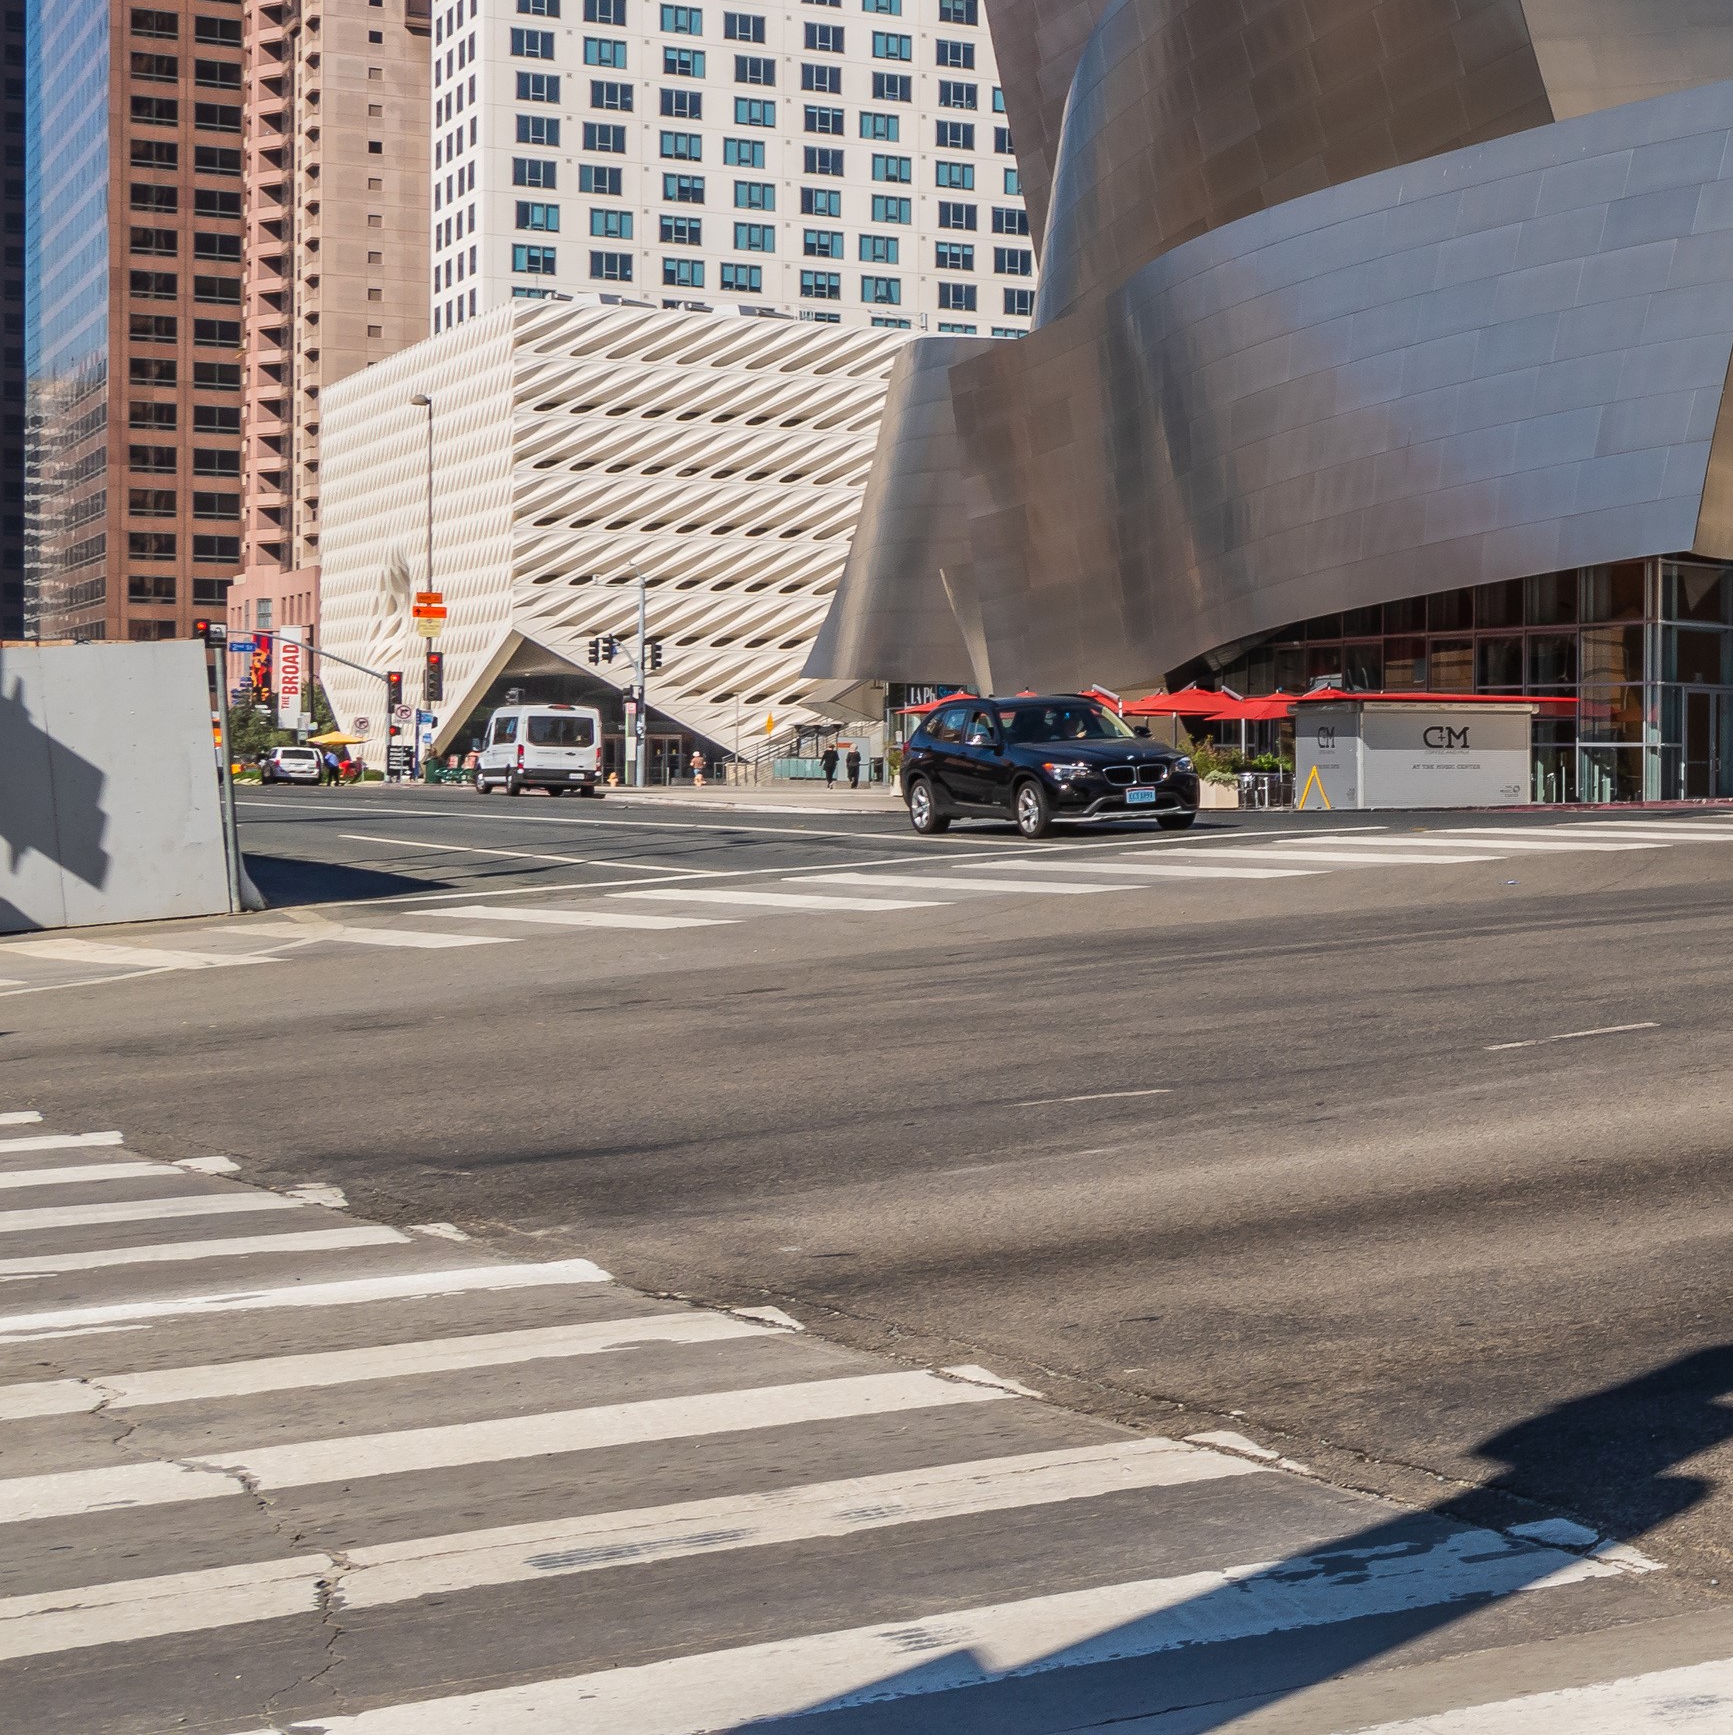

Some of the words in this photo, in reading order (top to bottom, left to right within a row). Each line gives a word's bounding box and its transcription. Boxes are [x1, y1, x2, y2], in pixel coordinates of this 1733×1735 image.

[281, 644, 299, 695] BROAD
[281, 696, 290, 710] THE
[911, 687, 922, 704] LA
